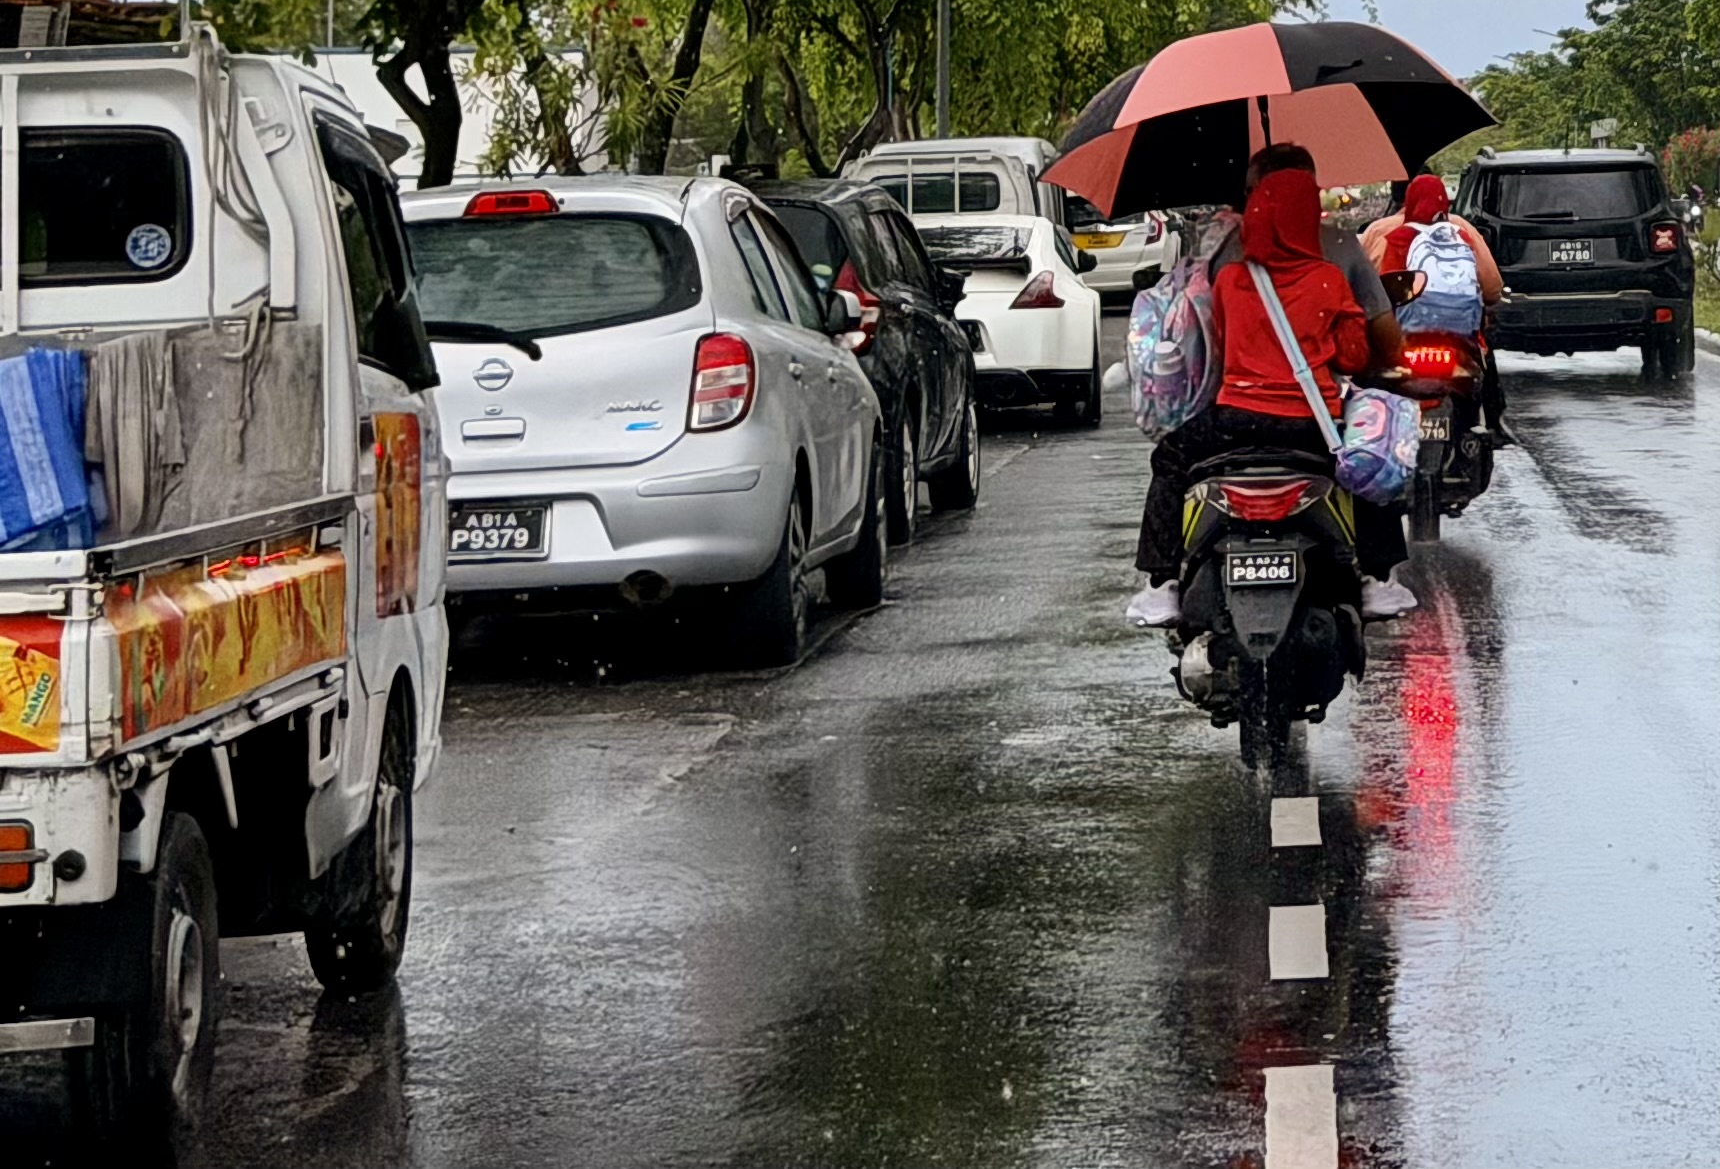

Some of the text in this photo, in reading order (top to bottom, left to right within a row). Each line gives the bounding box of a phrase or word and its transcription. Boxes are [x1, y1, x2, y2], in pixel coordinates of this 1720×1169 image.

[1552, 250, 1590, 262] P6780
[451, 528, 529, 551] P9379
[1232, 565, 1291, 581] P8406
[20, 672, 52, 724] MANGO
